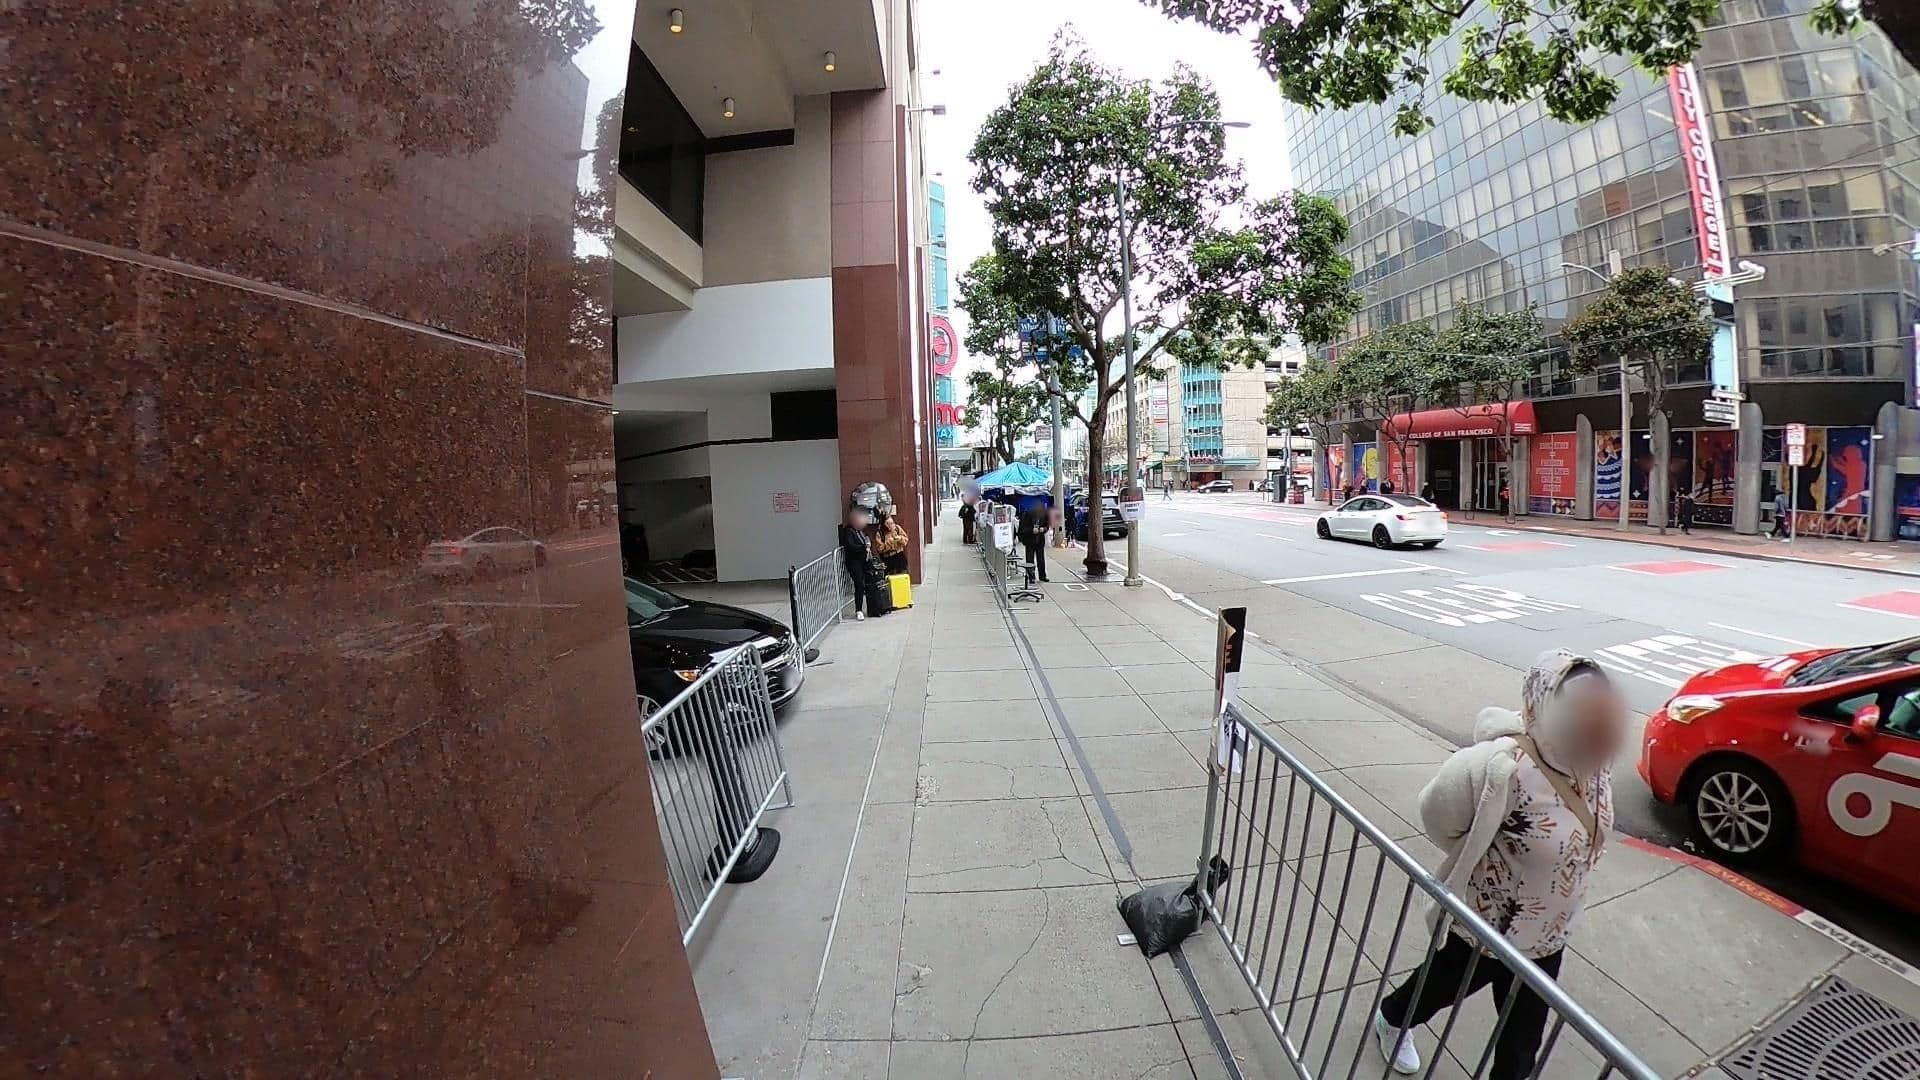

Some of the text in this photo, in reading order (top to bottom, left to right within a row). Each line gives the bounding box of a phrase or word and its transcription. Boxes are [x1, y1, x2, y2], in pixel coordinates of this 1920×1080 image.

[1676, 65, 1722, 252] ITY COLLEGE
[1457, 428, 1493, 436] FRANCISCO
[1360, 584, 1582, 627] CLEAR
